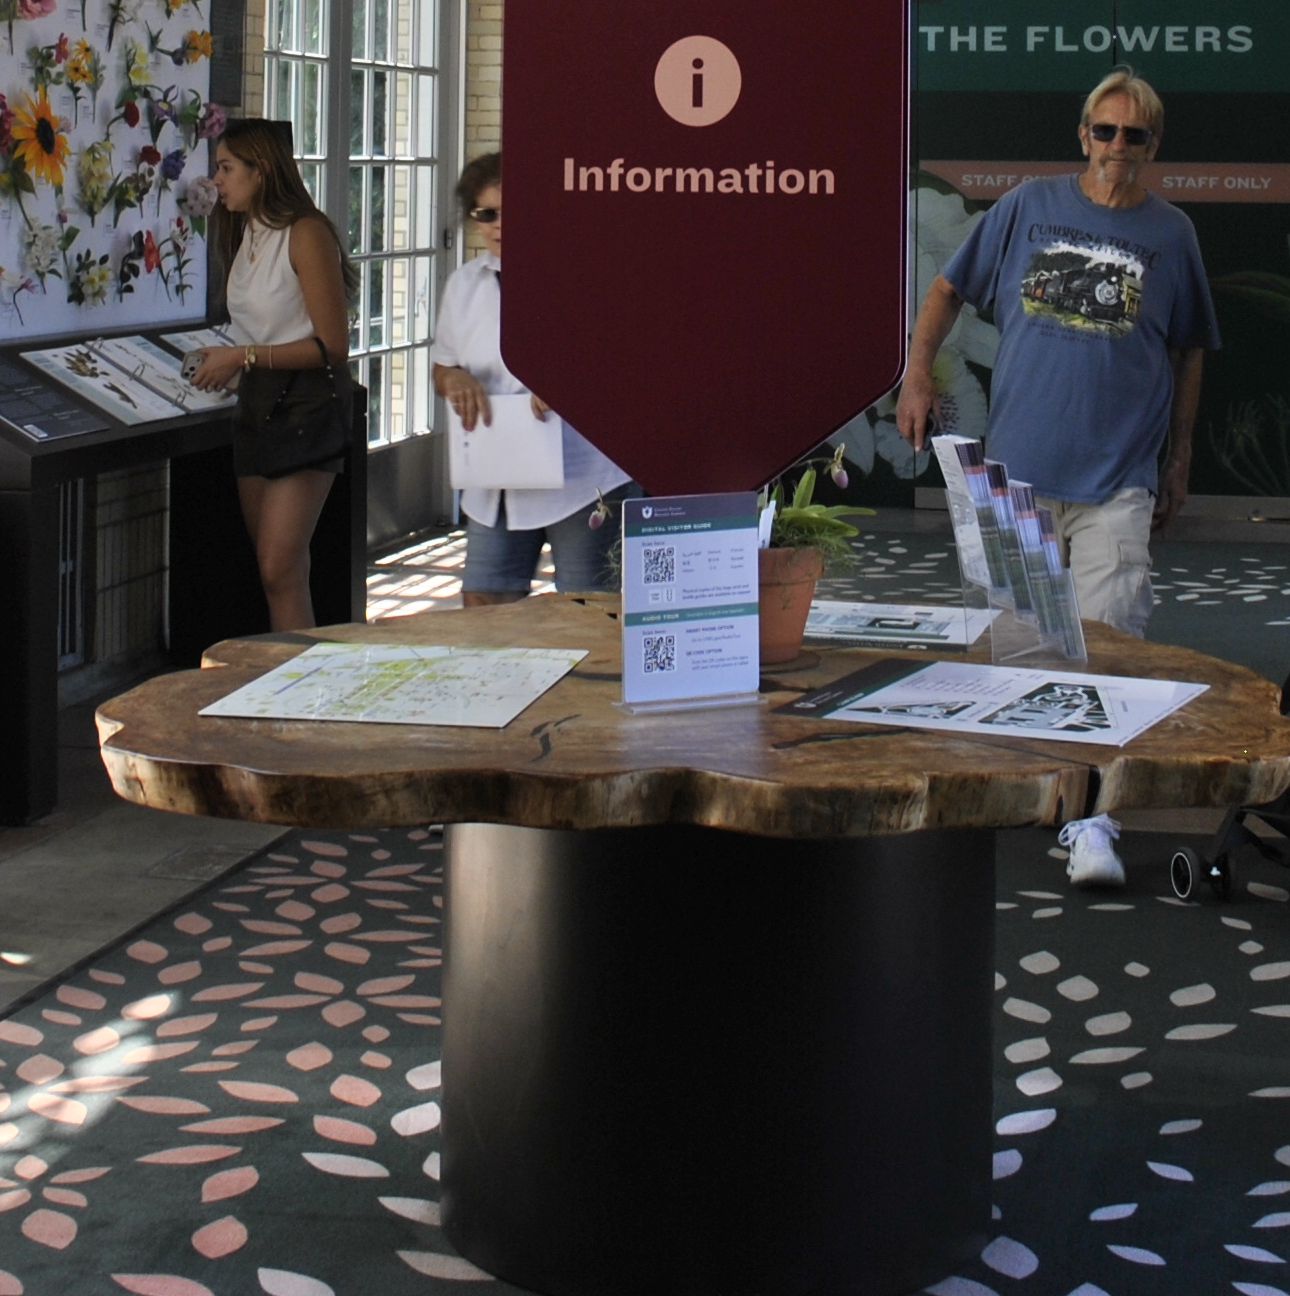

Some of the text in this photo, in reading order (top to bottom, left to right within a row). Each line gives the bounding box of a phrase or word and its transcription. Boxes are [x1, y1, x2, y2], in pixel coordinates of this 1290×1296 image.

[918, 24, 1254, 53] THE FLOWERS
[563, 157, 836, 195] Information
[961, 174, 1017, 187] STAFF
[1162, 175, 1272, 190] STAFF ONLY
